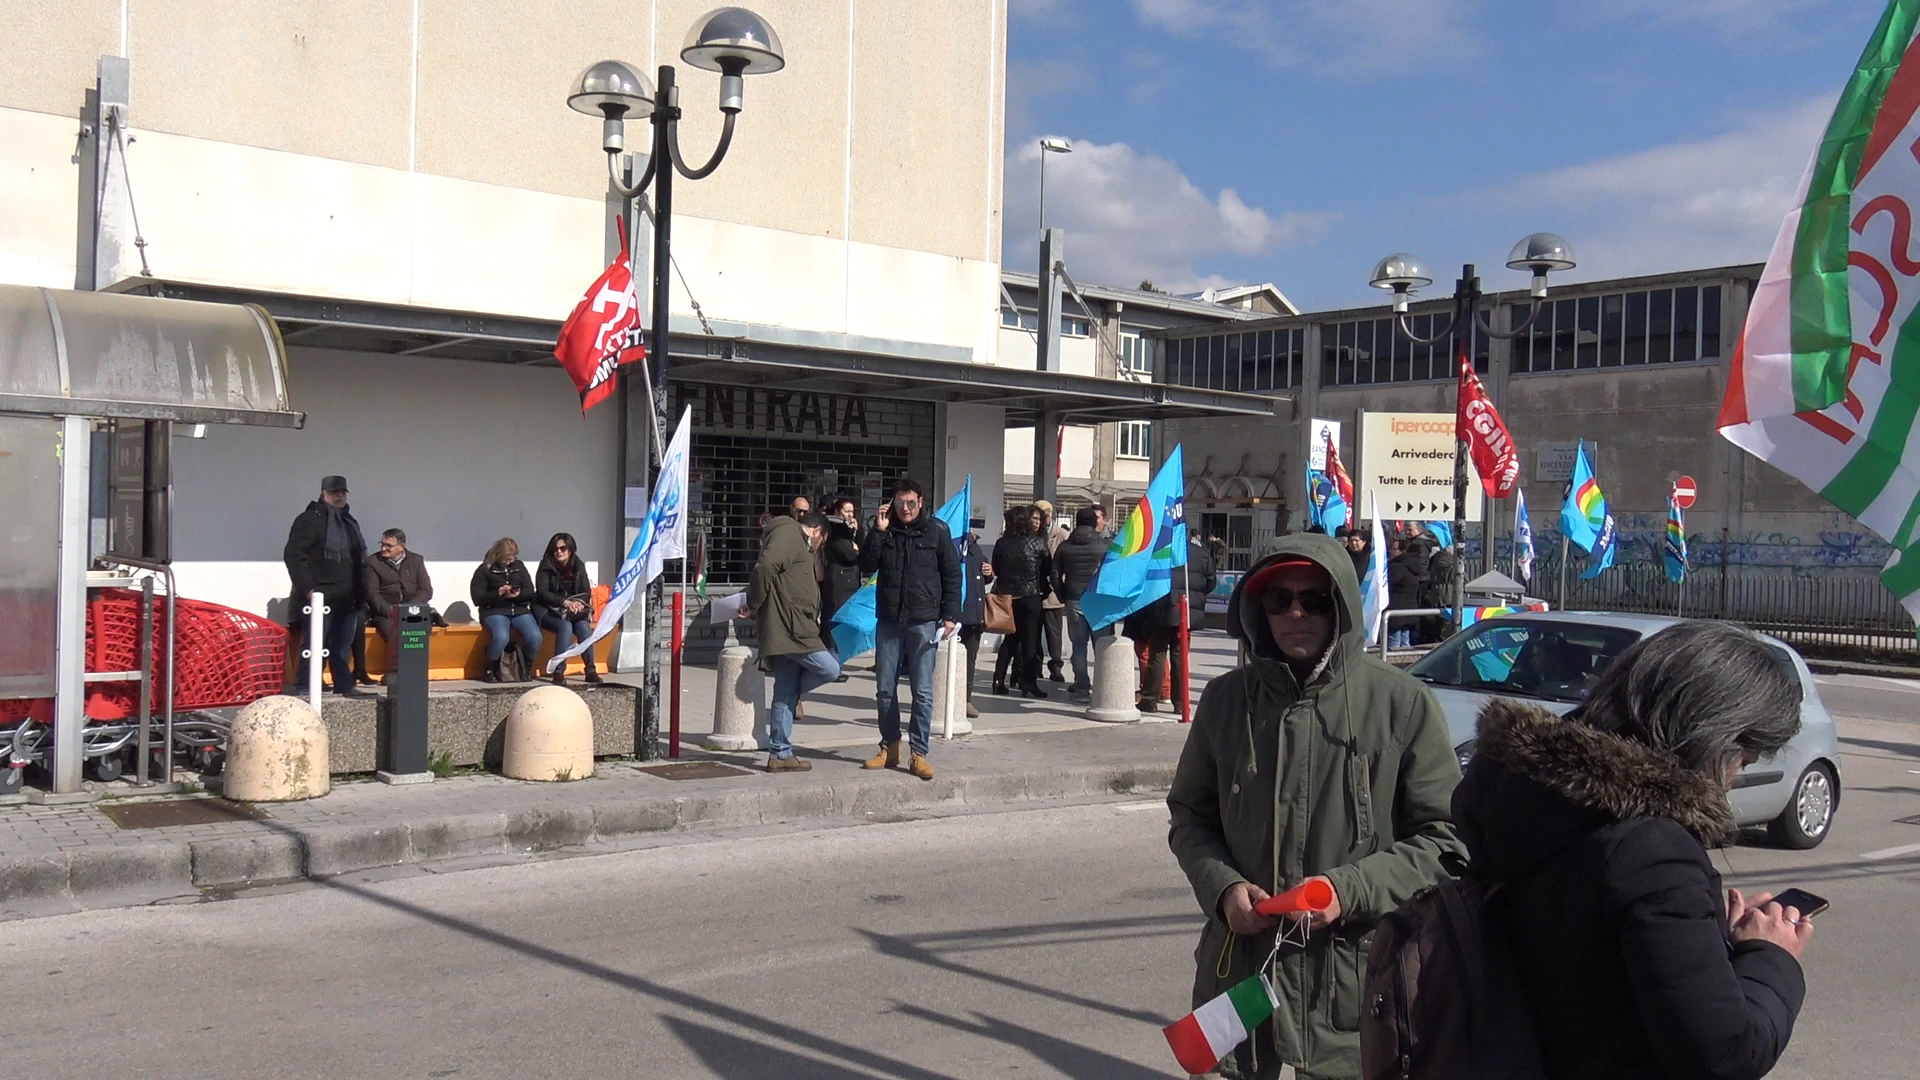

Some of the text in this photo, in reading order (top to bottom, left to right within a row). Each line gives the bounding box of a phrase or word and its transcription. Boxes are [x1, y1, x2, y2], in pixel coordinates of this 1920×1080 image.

[1466, 400, 1506, 457] CGIL
[1391, 448, 1455, 459] Arrivederc
[1378, 475, 1469, 486] Tutte le direzii
